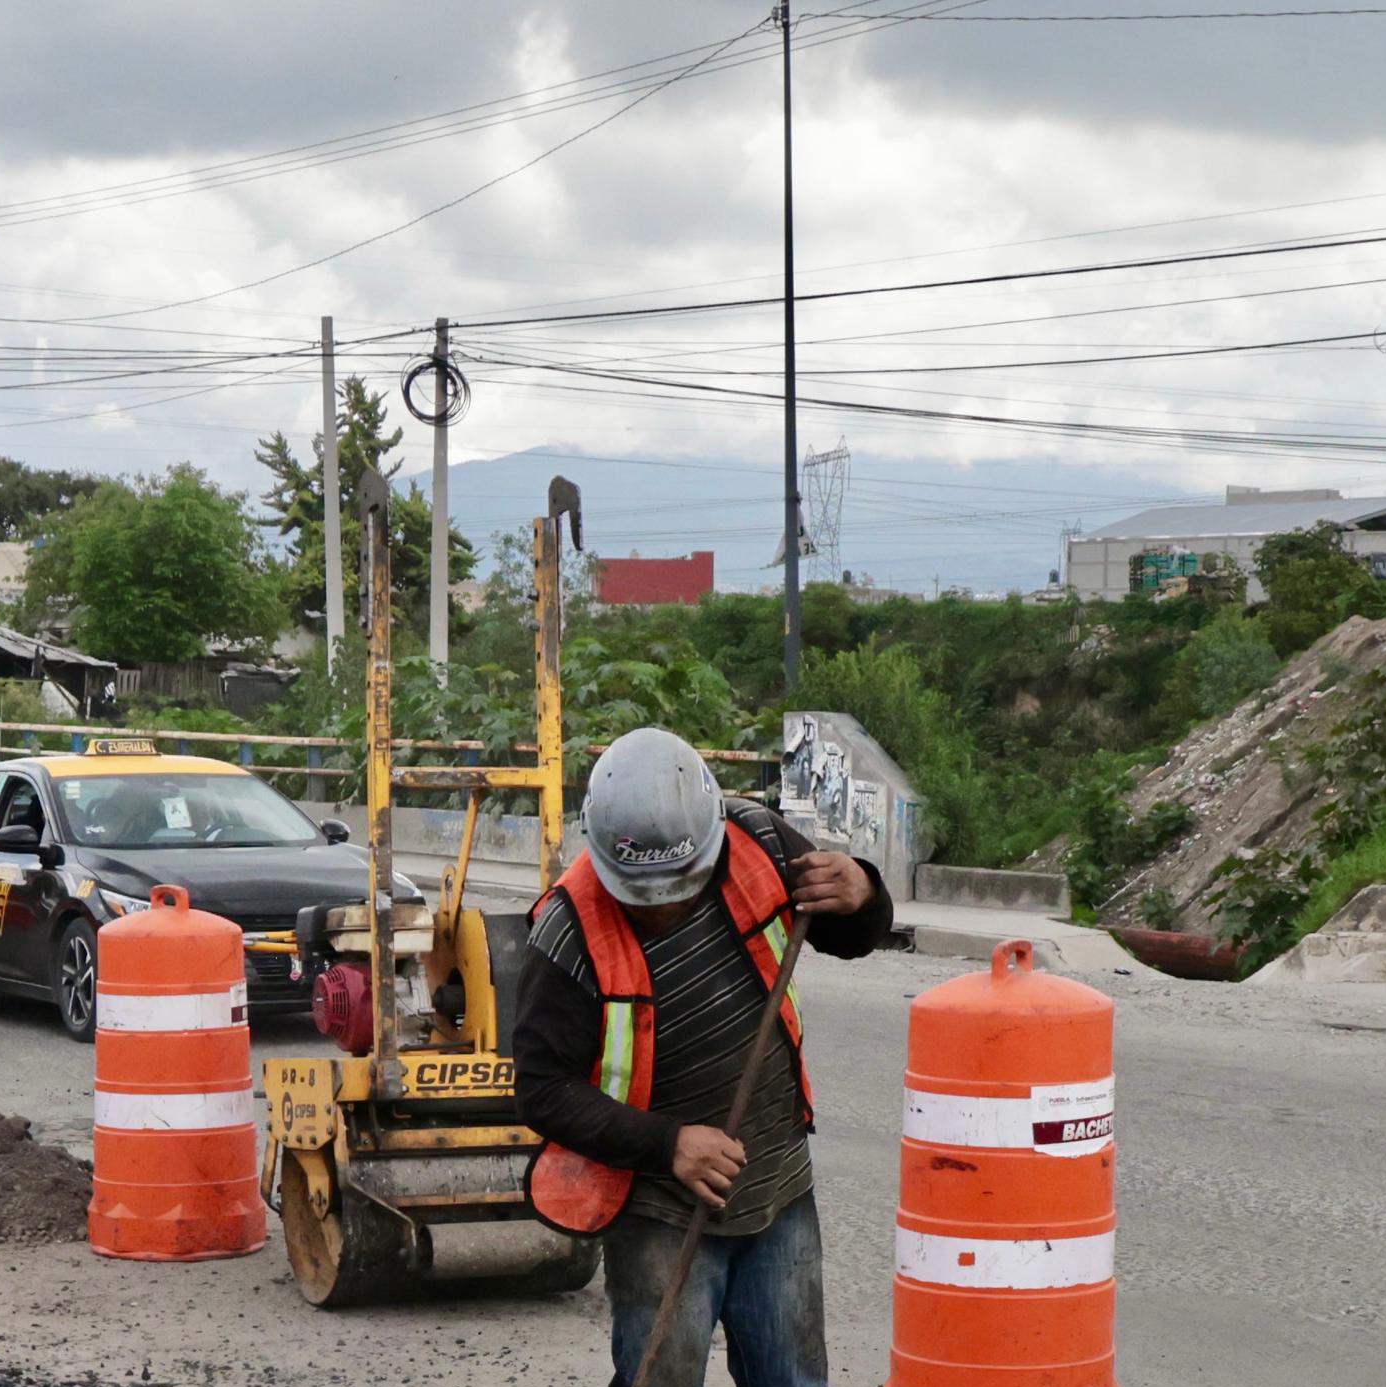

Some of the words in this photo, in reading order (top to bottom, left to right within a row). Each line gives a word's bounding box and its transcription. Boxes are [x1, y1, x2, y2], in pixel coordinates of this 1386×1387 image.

[615, 836, 695, 864] Patriots
[416, 1062, 513, 1085] CIPSA
[295, 1103, 316, 1119] CIPSA
